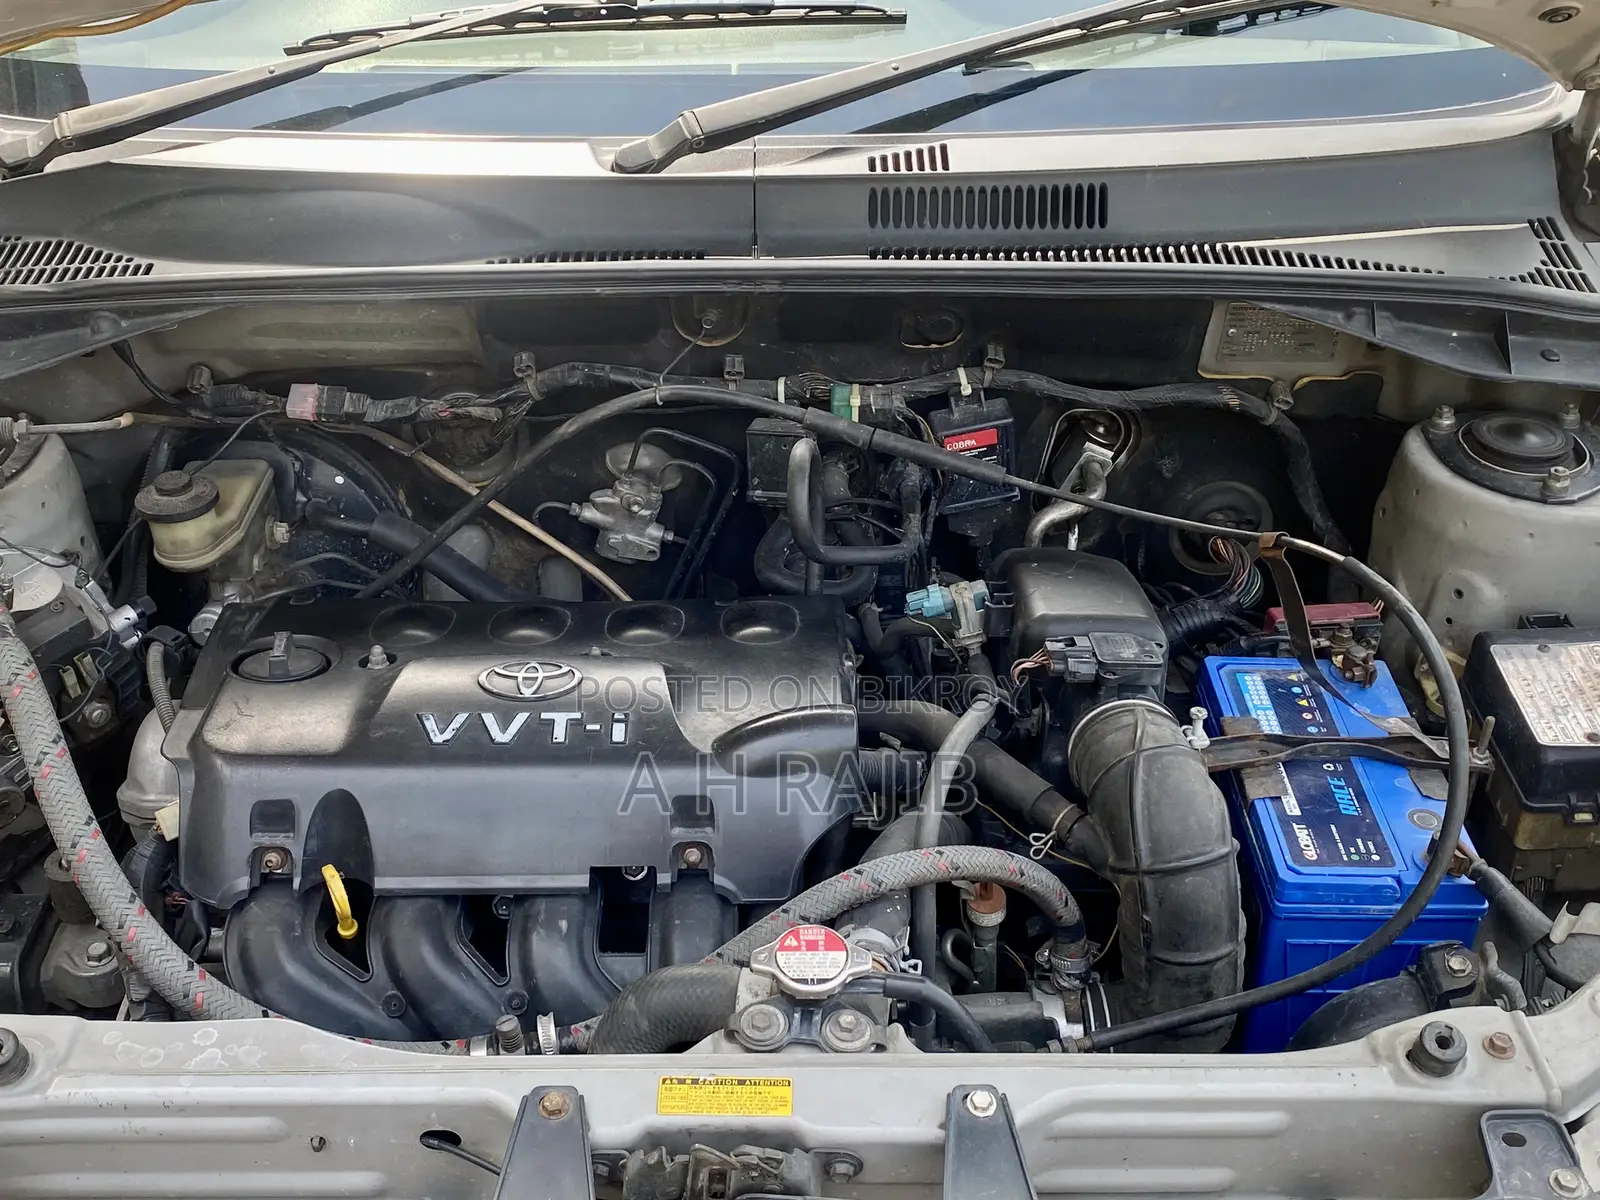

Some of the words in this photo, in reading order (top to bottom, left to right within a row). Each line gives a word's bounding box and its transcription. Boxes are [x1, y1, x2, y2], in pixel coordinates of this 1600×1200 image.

[946, 439, 977, 451] COBRA
[416, 711, 630, 746] VVT-i
[1327, 776, 1359, 816] RACE
[1292, 822, 1318, 860] GLOBATT
